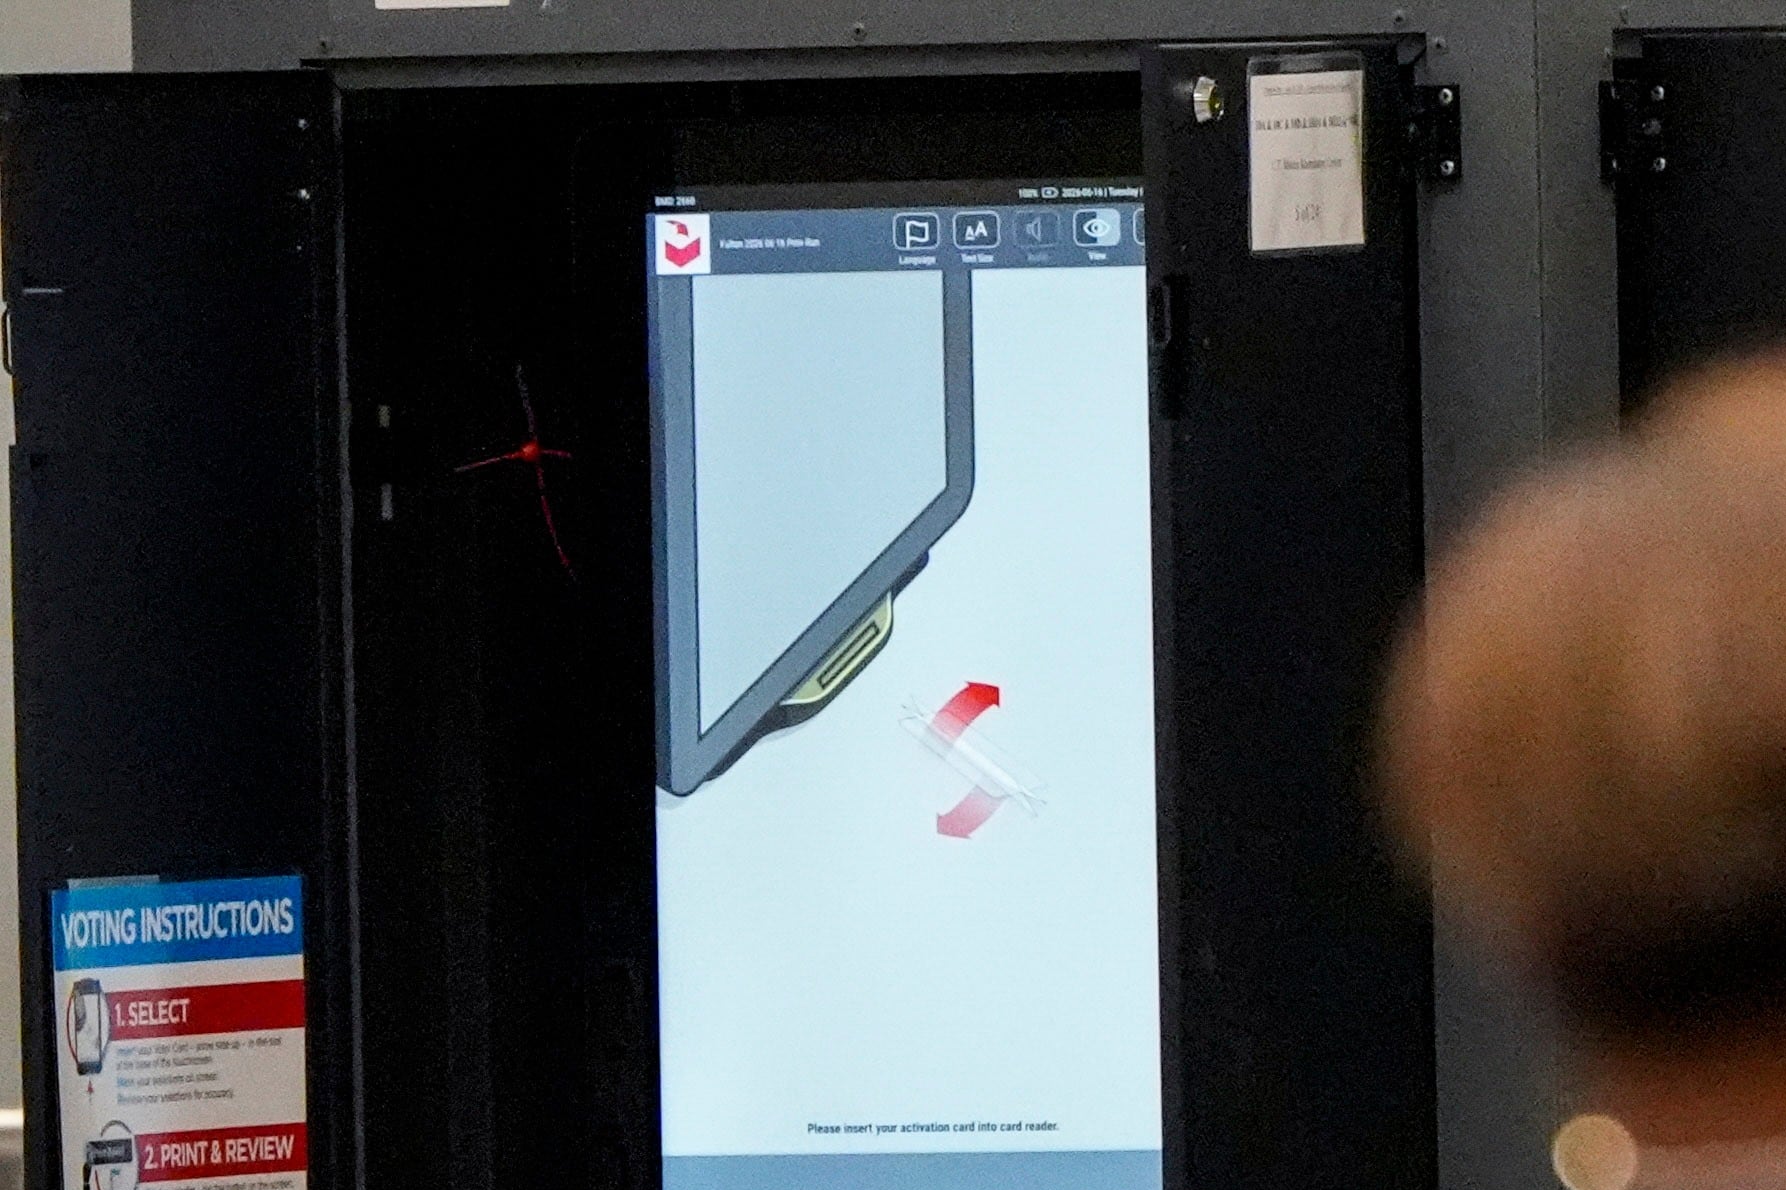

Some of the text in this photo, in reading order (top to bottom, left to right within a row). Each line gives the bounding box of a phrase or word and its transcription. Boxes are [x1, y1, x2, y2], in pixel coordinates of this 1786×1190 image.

[61, 897, 294, 949] VOTING INSTRUCTIONS
[114, 998, 190, 1027] 1. SELECT
[807, 1120, 1059, 1137] Please insert your activation card into card reader.
[144, 1134, 296, 1171] 2. PRINT & REVIEW
